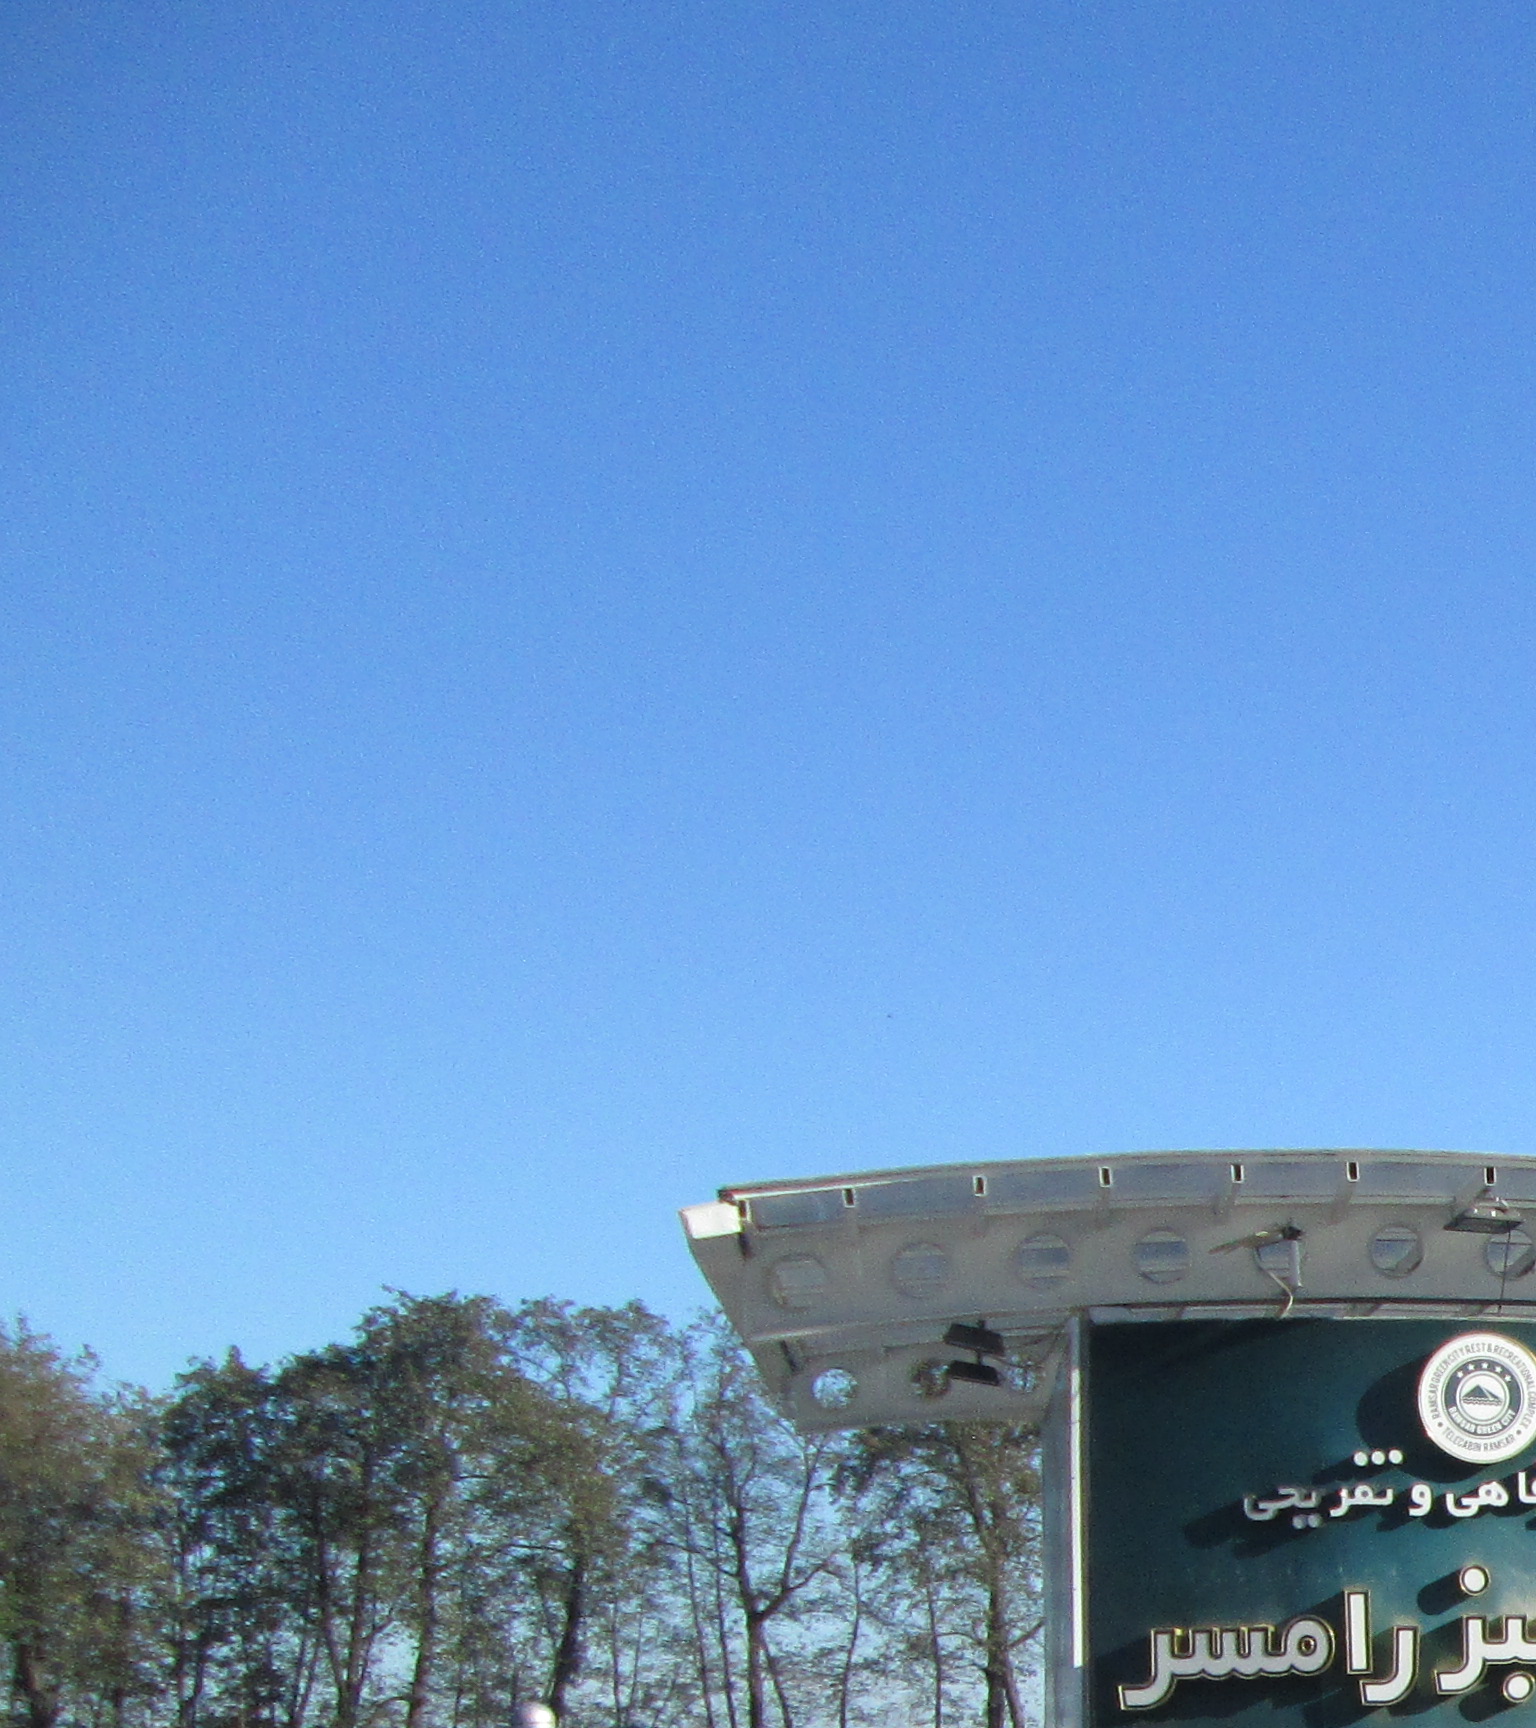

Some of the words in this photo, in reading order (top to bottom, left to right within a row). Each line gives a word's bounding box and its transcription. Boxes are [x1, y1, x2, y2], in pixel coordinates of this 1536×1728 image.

[1243, 1450, 1403, 1530] تفریحی
[1409, 1483, 1431, 1516] و
[1117, 1589, 1420, 1710] رامسر
